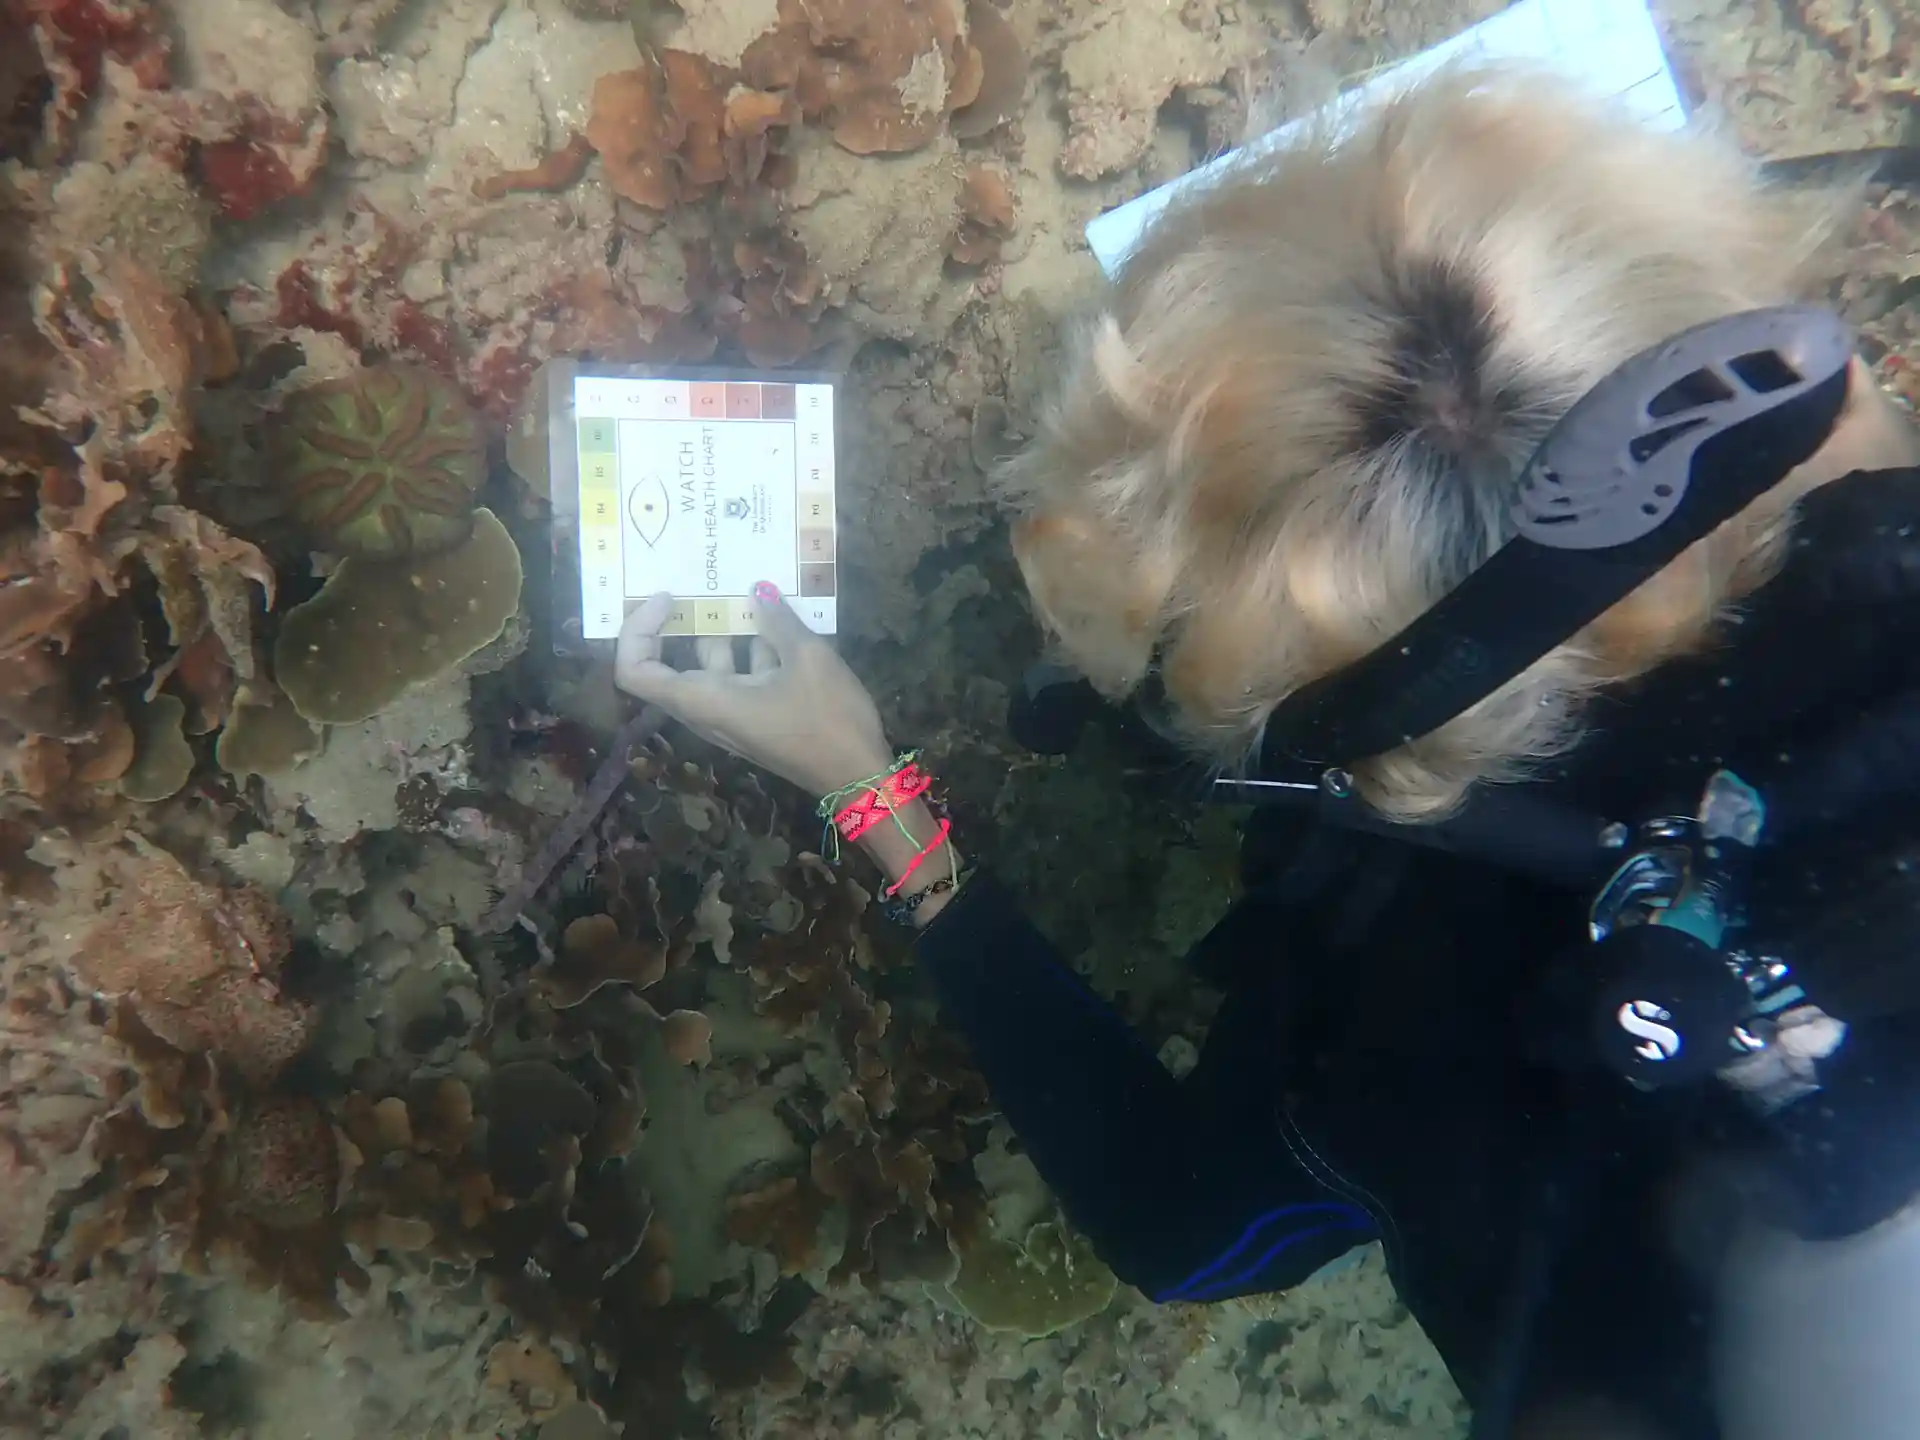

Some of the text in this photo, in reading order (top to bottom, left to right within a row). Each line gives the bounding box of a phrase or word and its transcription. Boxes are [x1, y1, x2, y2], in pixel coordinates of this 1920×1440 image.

[679, 441, 695, 513] WATCH
[702, 425, 719, 591] CORAL HEALTH CHART
